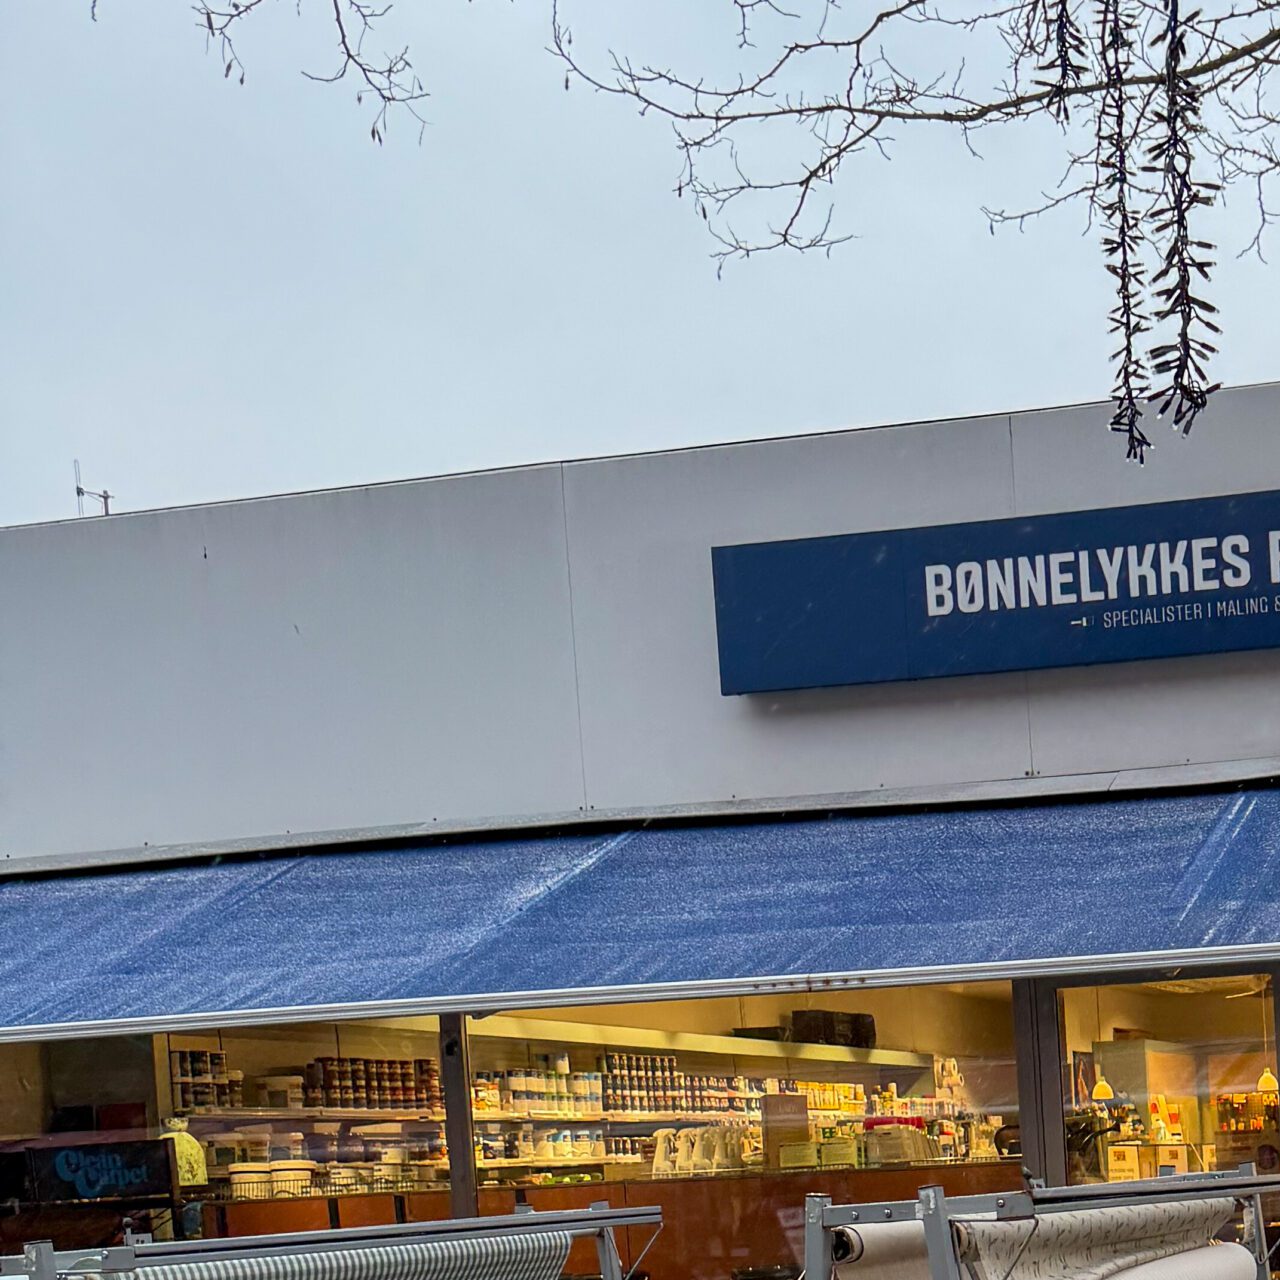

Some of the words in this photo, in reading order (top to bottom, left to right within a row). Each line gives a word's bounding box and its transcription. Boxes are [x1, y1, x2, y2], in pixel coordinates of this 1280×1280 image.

[925, 534, 1251, 617] BØNNELYKKES
[1103, 602, 1203, 628] SPECIALISTER
[1207, 602, 1212, 618] I
[1216, 596, 1269, 617] MALING
